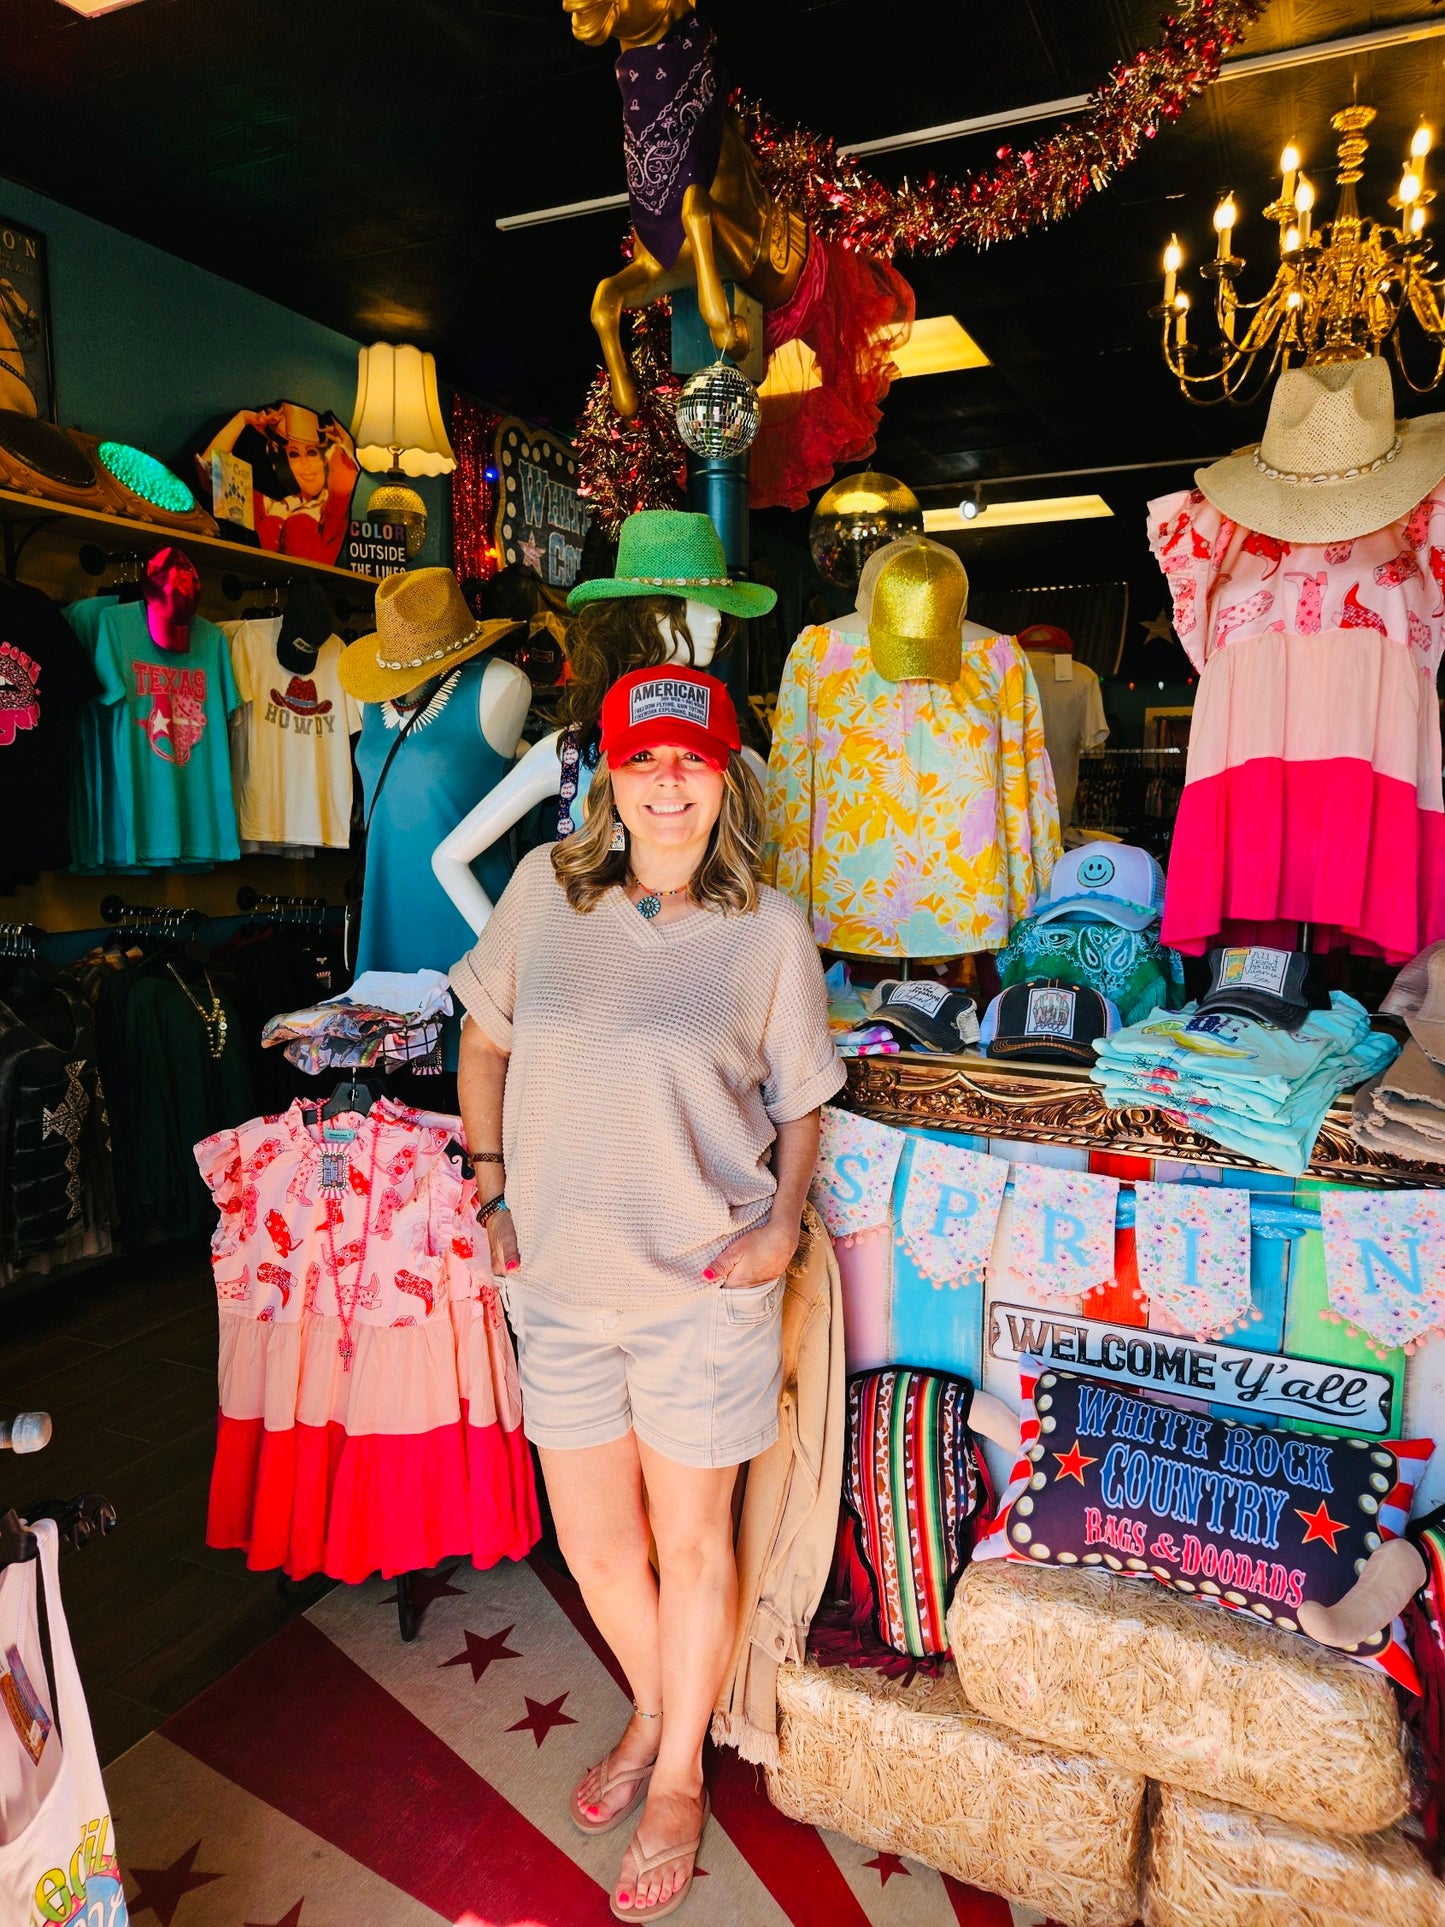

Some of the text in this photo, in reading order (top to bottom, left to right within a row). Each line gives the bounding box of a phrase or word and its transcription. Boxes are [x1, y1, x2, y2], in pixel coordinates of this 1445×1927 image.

[350, 521, 404, 541] COLOR
[350, 542, 406, 562] OUTSIDE
[131, 660, 208, 702] TEXAS
[634, 682, 705, 704] AMERICAN
[264, 703, 336, 735] HOWDY
[1007, 1314, 1370, 1417] WELCOME Y'all
[1076, 1384, 1336, 1494] WHITE ROCK
[1099, 1441, 1289, 1551] COUNTRY
[1084, 1506, 1147, 1559] RAGS
[1180, 1533, 1307, 1610] DOODADS
